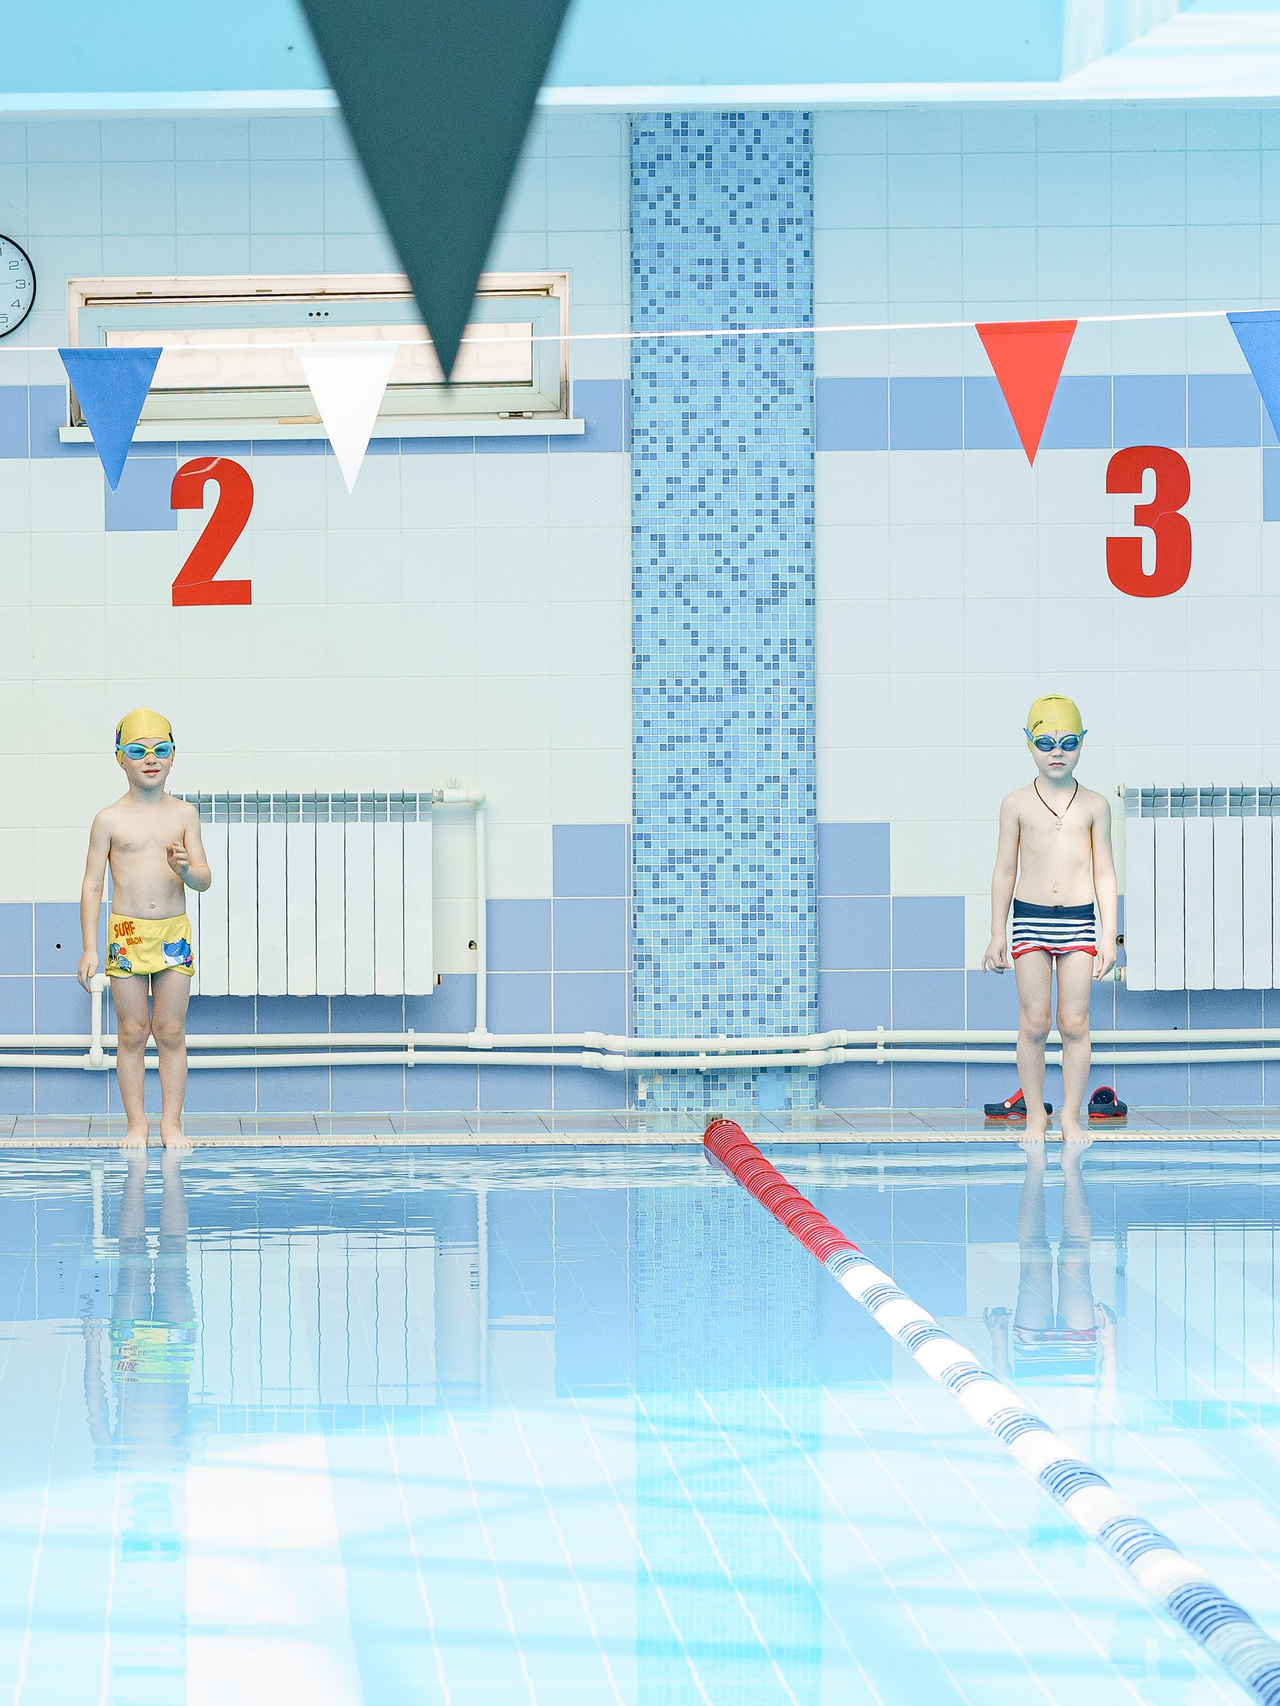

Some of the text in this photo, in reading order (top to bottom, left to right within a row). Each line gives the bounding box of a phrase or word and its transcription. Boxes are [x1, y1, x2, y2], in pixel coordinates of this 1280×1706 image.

[8, 260, 19, 270] 2
[15, 279, 26, 289] 3
[10, 299, 21, 308] 4
[1106, 446, 1192, 598] 3
[171, 456, 254, 607] 2
[113, 921, 136, 938] SURF
